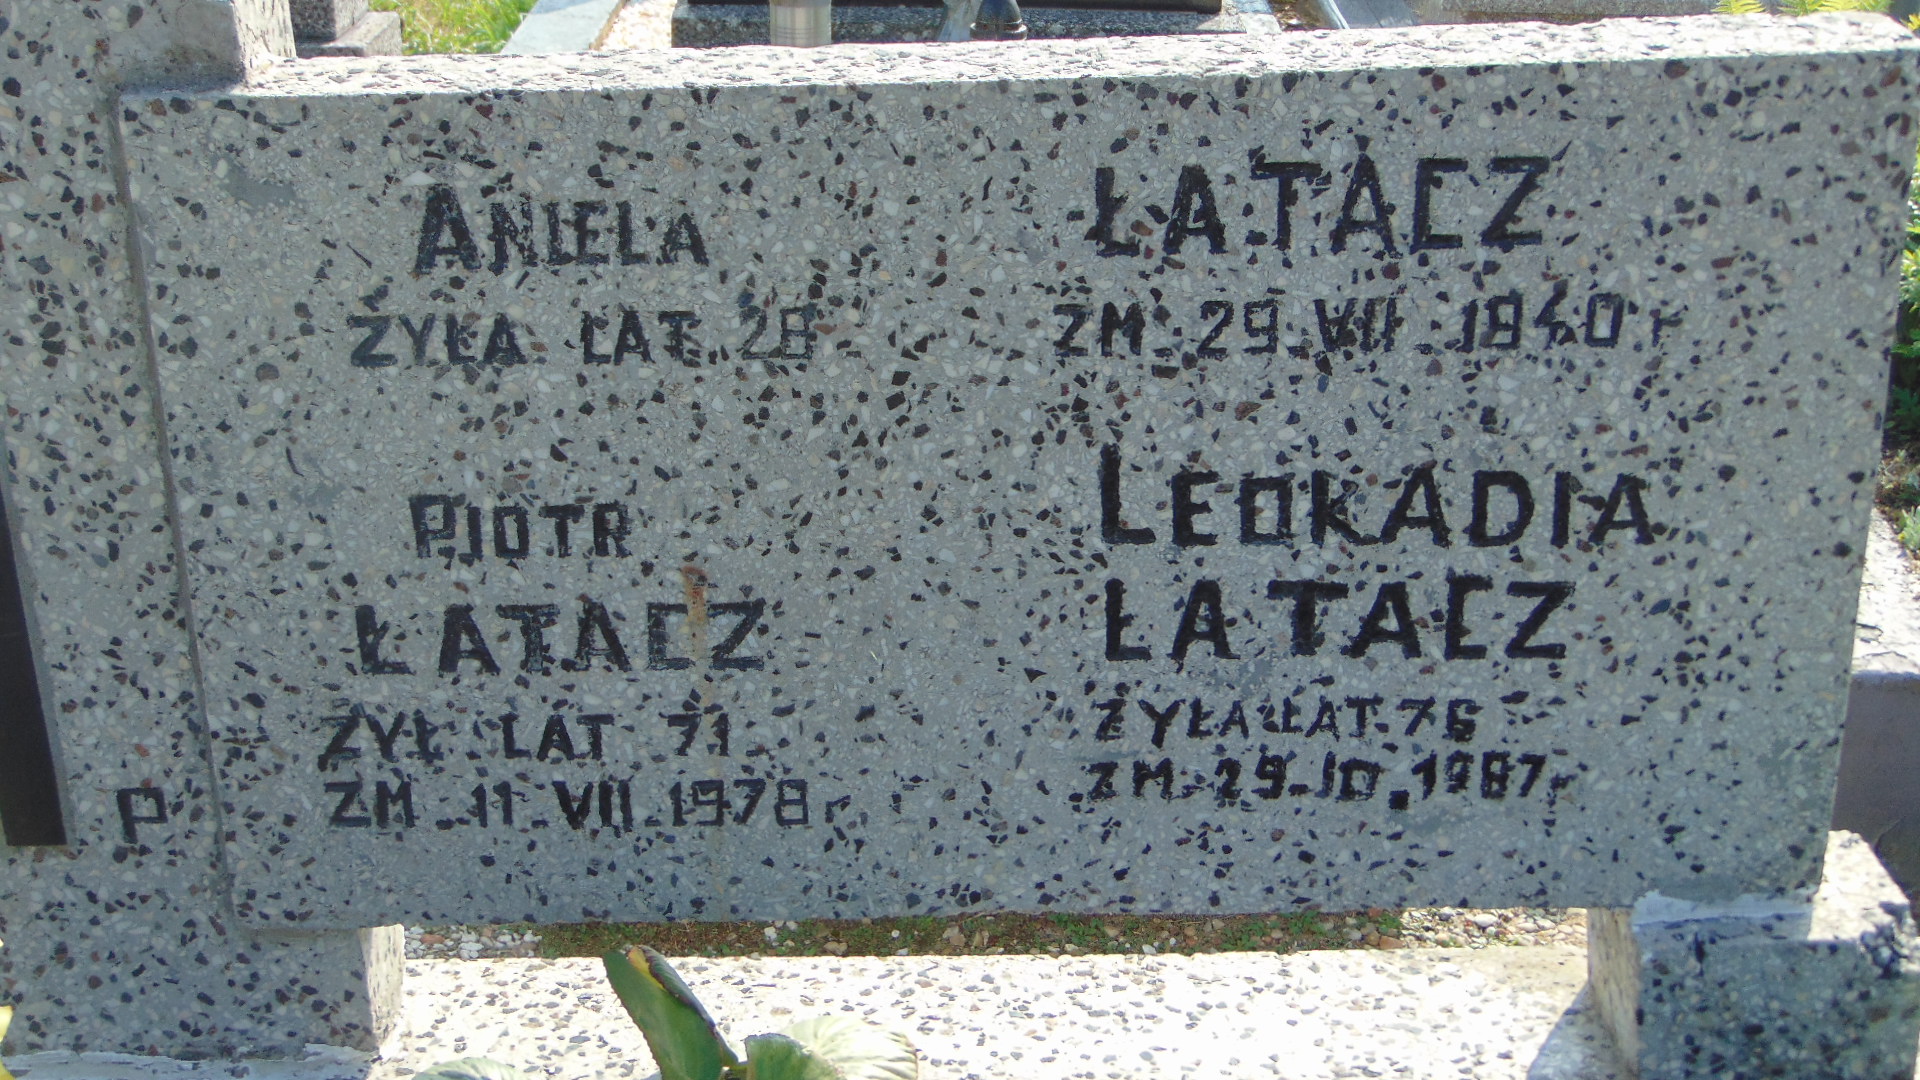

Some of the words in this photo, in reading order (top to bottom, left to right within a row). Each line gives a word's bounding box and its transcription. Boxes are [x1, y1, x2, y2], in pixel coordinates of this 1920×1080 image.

[414, 184, 709, 277] ANIELA
[1094, 152, 1550, 258] ŁATACZ
[581, 304, 702, 366] LAT
[741, 304, 818, 361] 28
[408, 494, 633, 560] PIOTR
[1098, 442, 1656, 549] LEOKADIA
[355, 597, 766, 676] ŁATACZ
[1103, 570, 1577, 665] ŁATACZ
[499, 711, 615, 761] LAT
[667, 712, 730, 757] 71
[1281, 695, 1384, 742] LAT
[1399, 697, 1481, 743] 76
[116, 786, 169, 844] P
